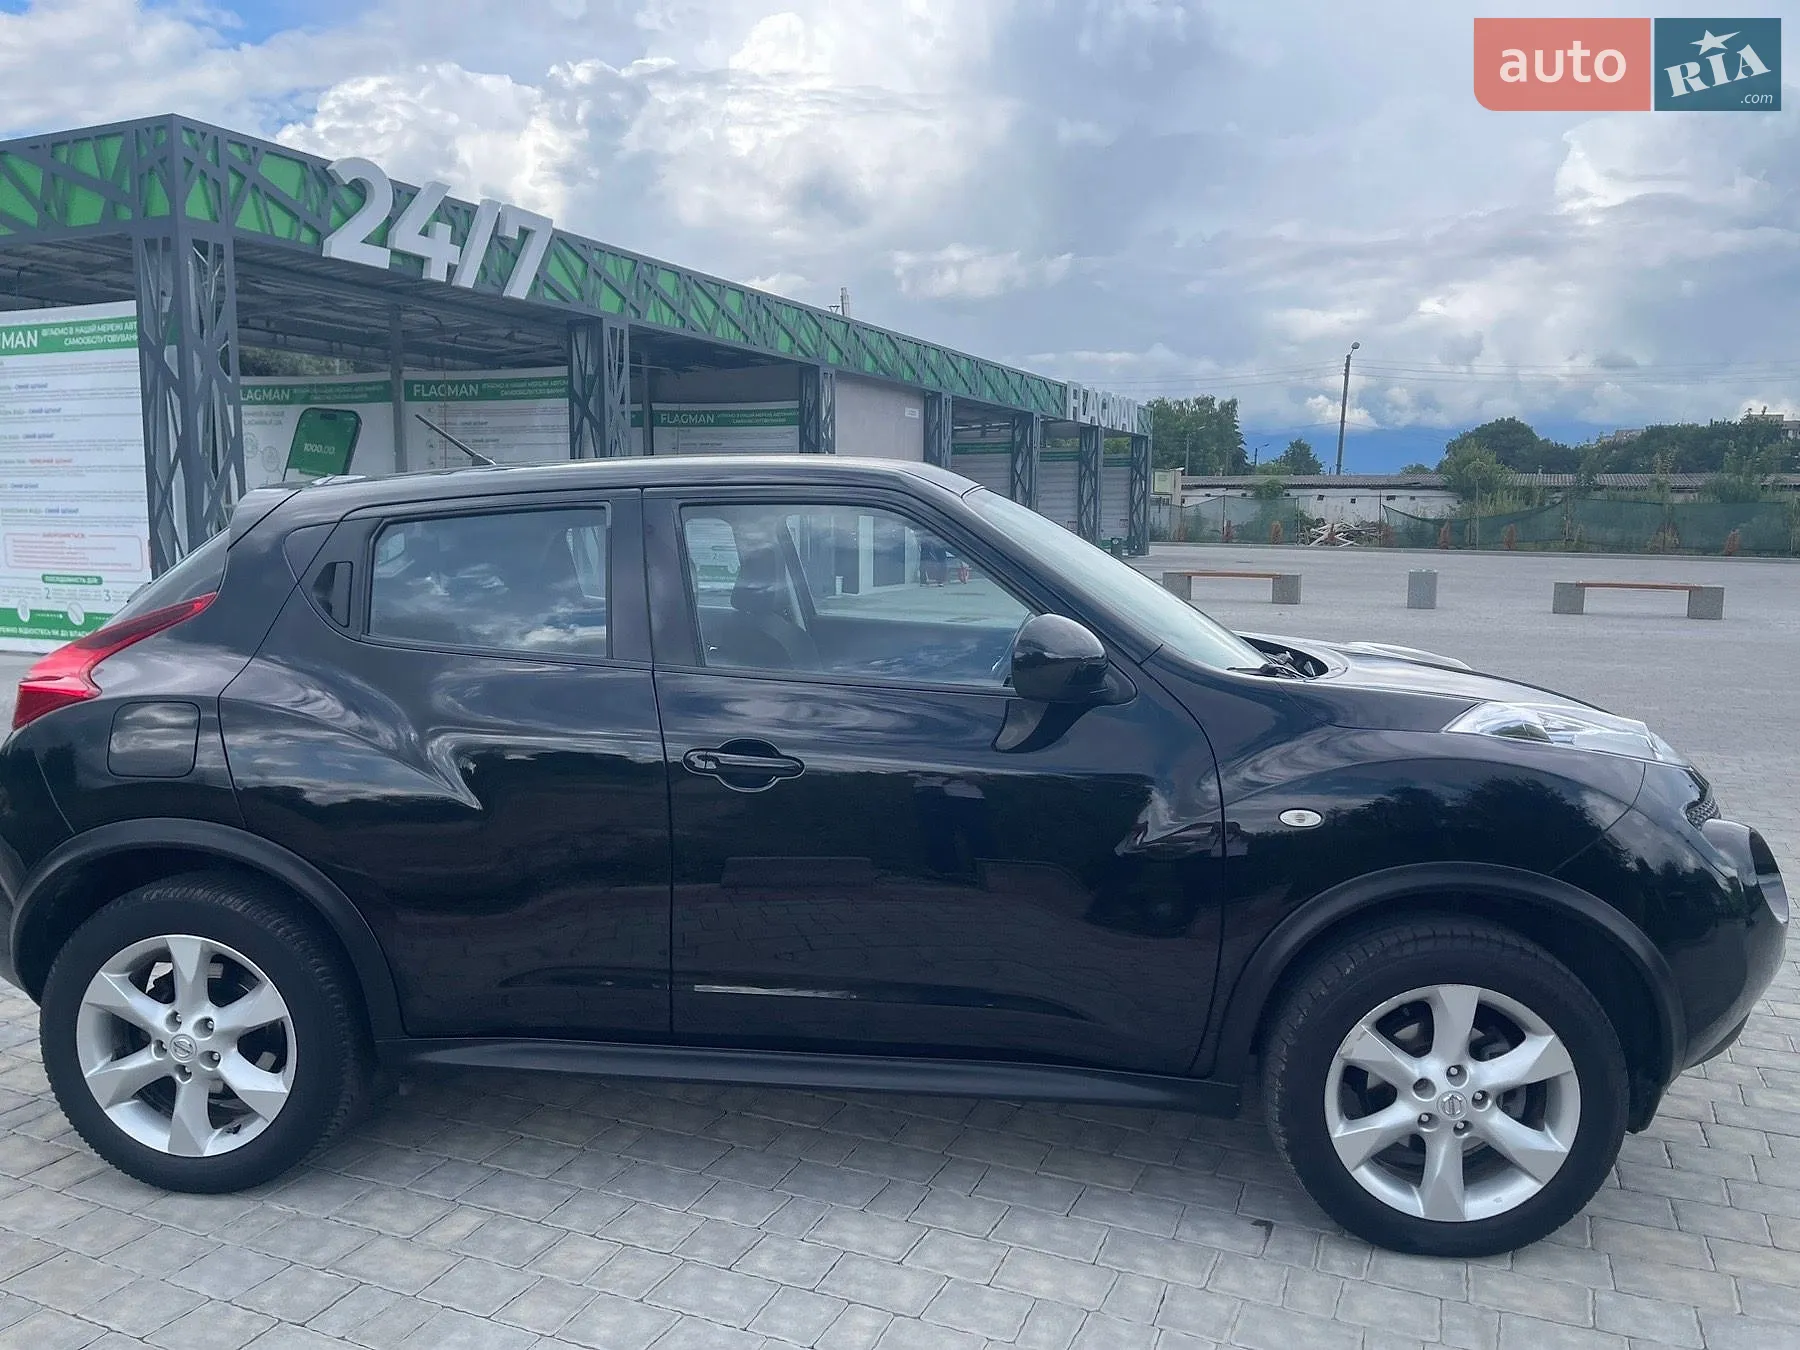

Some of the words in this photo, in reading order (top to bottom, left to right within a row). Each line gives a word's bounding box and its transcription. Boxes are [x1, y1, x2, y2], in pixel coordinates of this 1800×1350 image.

[322, 156, 553, 299] 24/7
[0, 330, 38, 350] MAN
[660, 413, 715, 424] FLAGMAN
